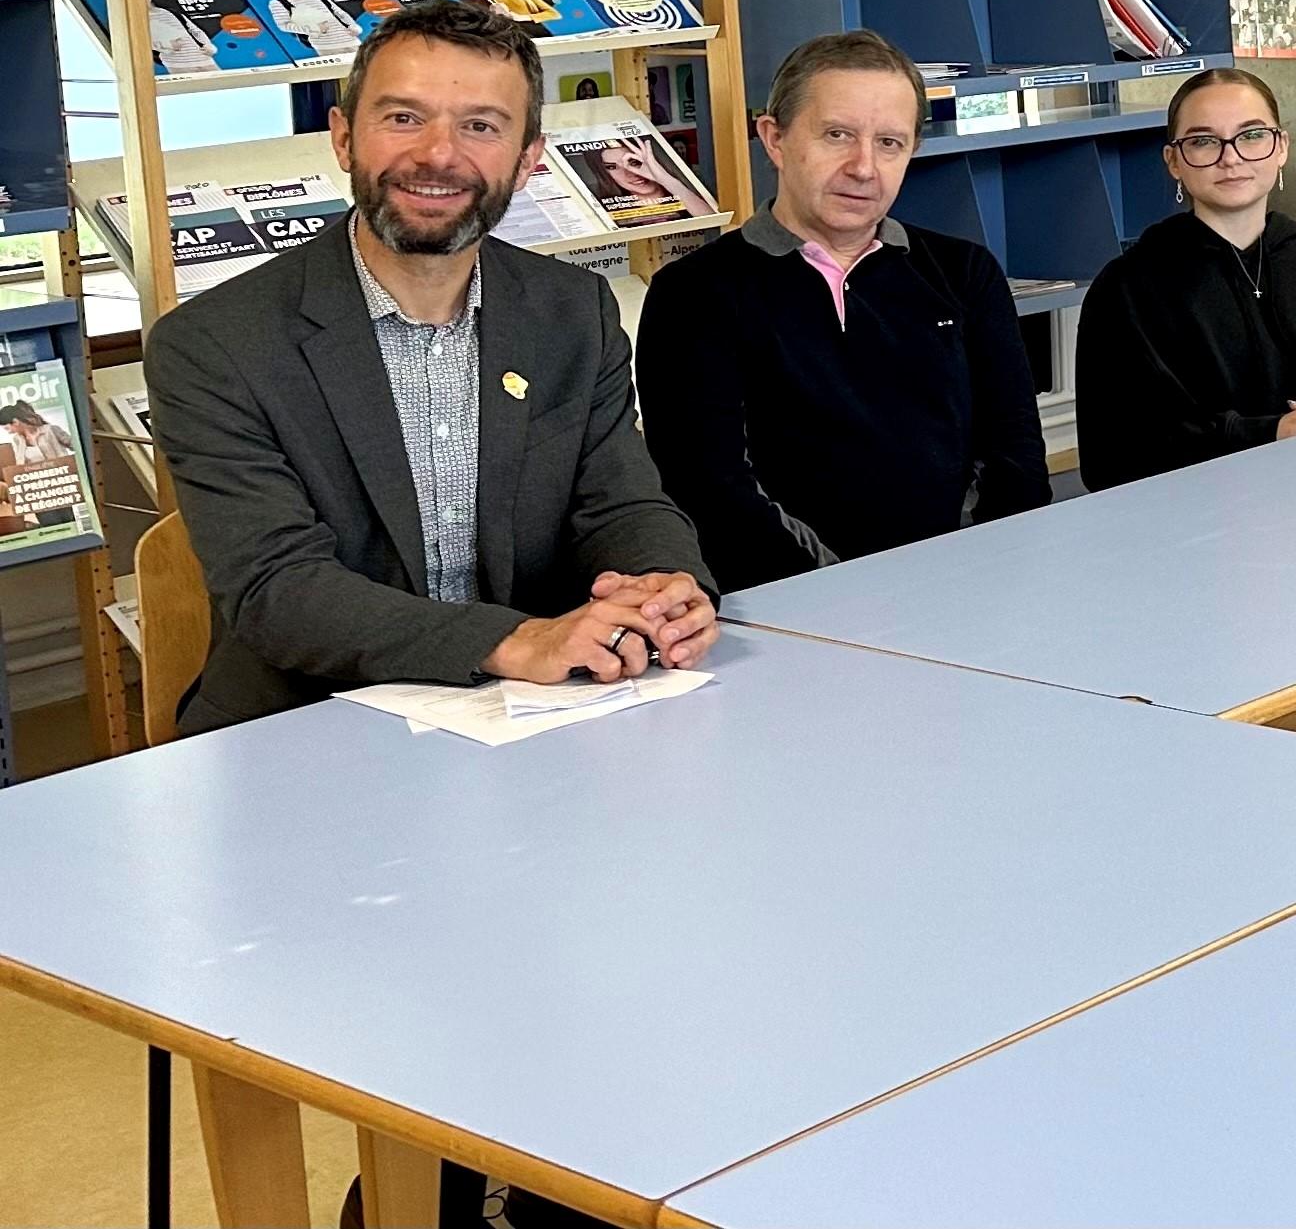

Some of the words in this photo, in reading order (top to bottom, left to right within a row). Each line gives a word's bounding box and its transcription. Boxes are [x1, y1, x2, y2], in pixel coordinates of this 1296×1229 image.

[564, 141, 607, 154] HANDI
[246, 188, 303, 201] DIPLÔMES
[261, 209, 285, 219] LES
[267, 217, 325, 236] CAP
[171, 228, 215, 247] AP
[14, 466, 69, 483] COMMENT
[23, 474, 79, 491] PRÉPARER
[25, 485, 77, 501] CHANGER
[15, 504, 30, 514] DE
[32, 496, 74, 510] RÉGION
